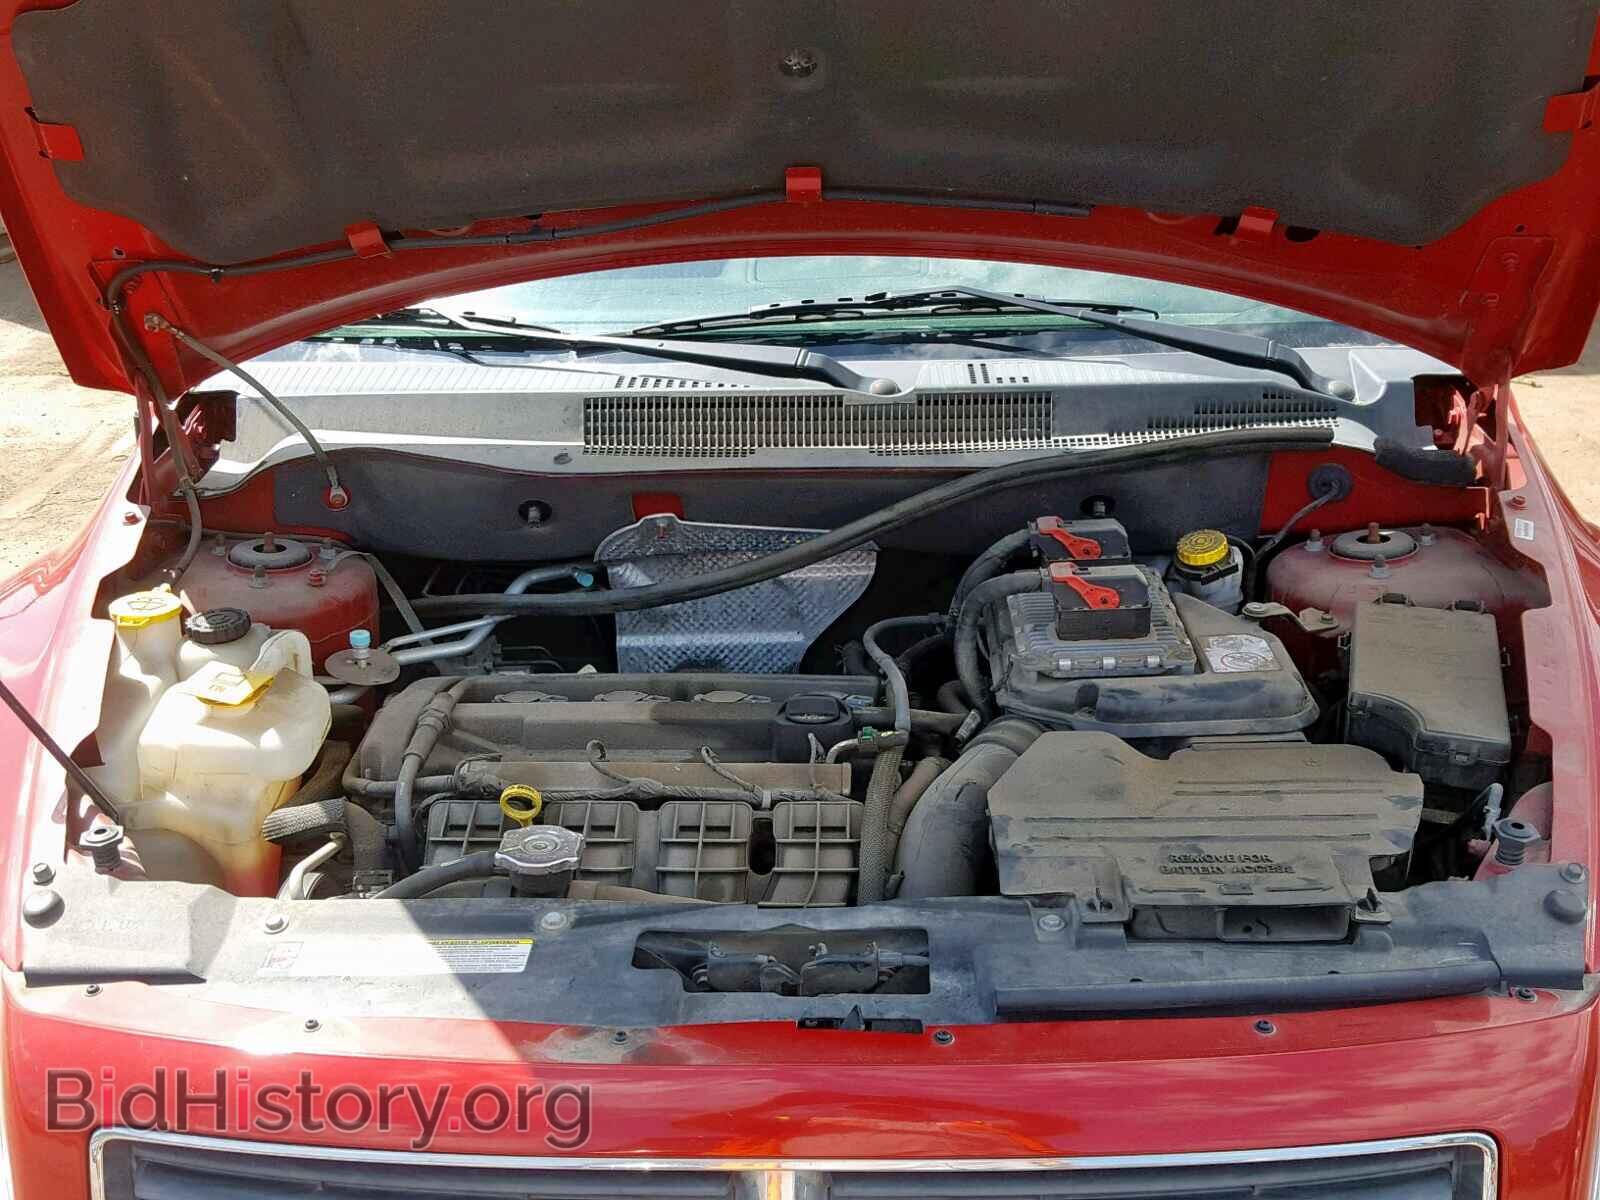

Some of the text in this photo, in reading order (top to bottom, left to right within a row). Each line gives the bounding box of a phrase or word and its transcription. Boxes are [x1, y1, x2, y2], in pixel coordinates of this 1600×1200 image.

[1168, 854, 1273, 864] REMOVE FOR
[1160, 864, 1296, 875] BATTERY ACCESS
